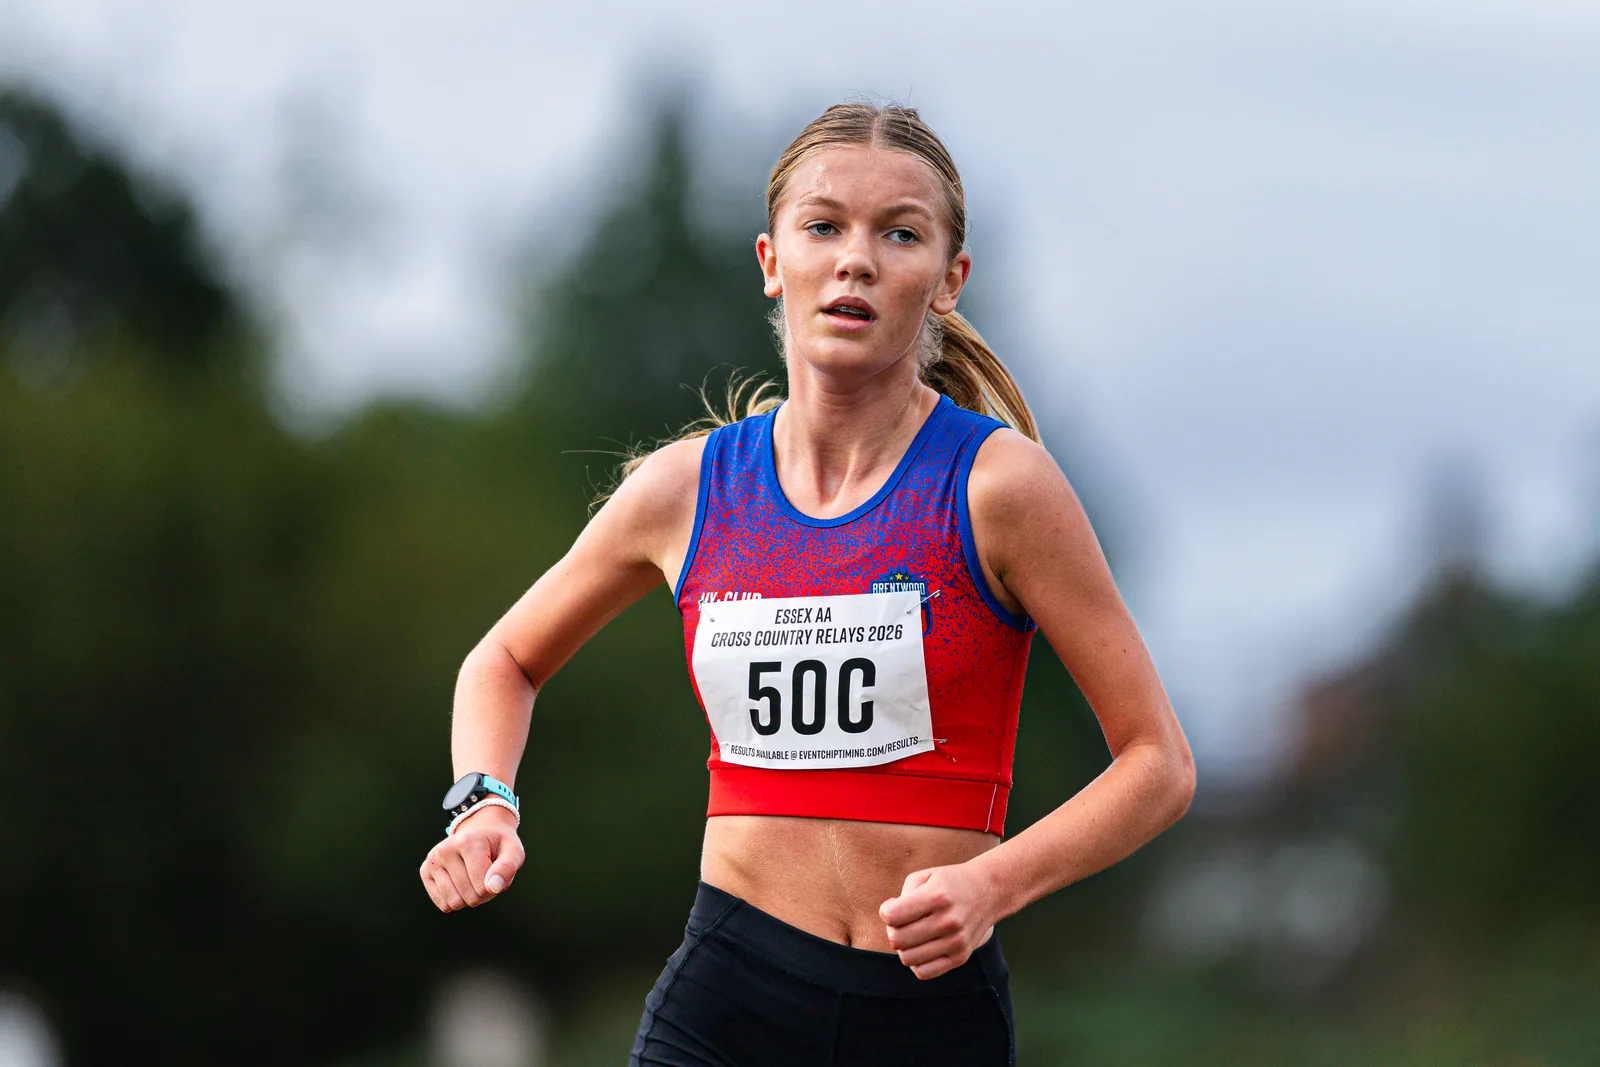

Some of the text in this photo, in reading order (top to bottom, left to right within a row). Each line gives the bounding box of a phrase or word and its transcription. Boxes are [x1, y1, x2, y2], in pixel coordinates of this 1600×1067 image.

[873, 582, 926, 595] BRENTWOOD
[775, 607, 832, 624] ESSEX AA
[711, 624, 903, 647] CROSS COUNTRY RELAYS 2026
[748, 657, 876, 736] 50C
[730, 736, 919, 760] RESULTS AVAILABLE @ EVENTCHIPTIMING.COM/RESULTS
